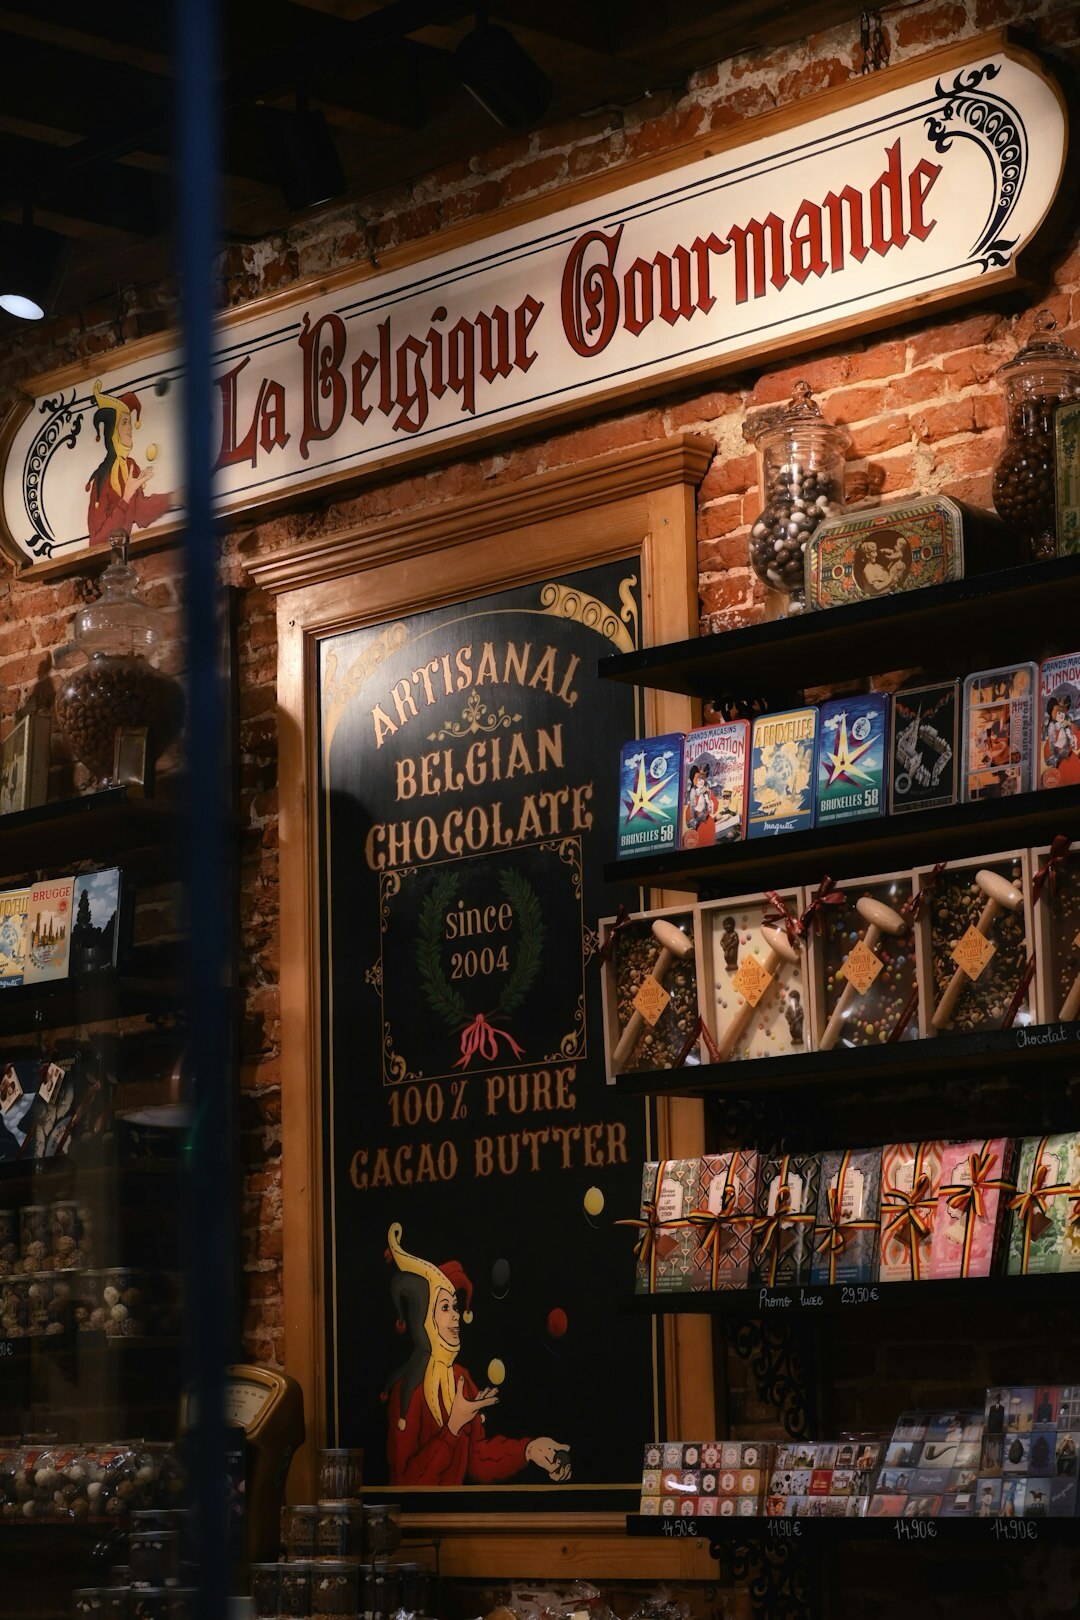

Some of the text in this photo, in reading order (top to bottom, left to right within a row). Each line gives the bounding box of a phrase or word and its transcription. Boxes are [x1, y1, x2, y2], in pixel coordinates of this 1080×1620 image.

[213, 137, 943, 470] La Belgique Gourmande
[370, 641, 581, 750] ARTISANAL
[394, 722, 565, 802] BELGIAN
[820, 793, 863, 813] BRUXELLES
[864, 788, 879, 807] 58
[365, 781, 594, 872] CHOCOLATE
[621, 829, 659, 847] BRUXELLES
[660, 824, 674, 842] 58
[33, 886, 71, 902] BRUGGE
[445, 900, 513, 941] since
[451, 945, 510, 980] 2004
[1016, 1025, 1068, 1048] Chocolat
[485, 1064, 577, 1116] PURE
[350, 1121, 630, 1190] CACAO BUTTER
[759, 1288, 792, 1309] Promo
[799, 1288, 824, 1306] luxe
